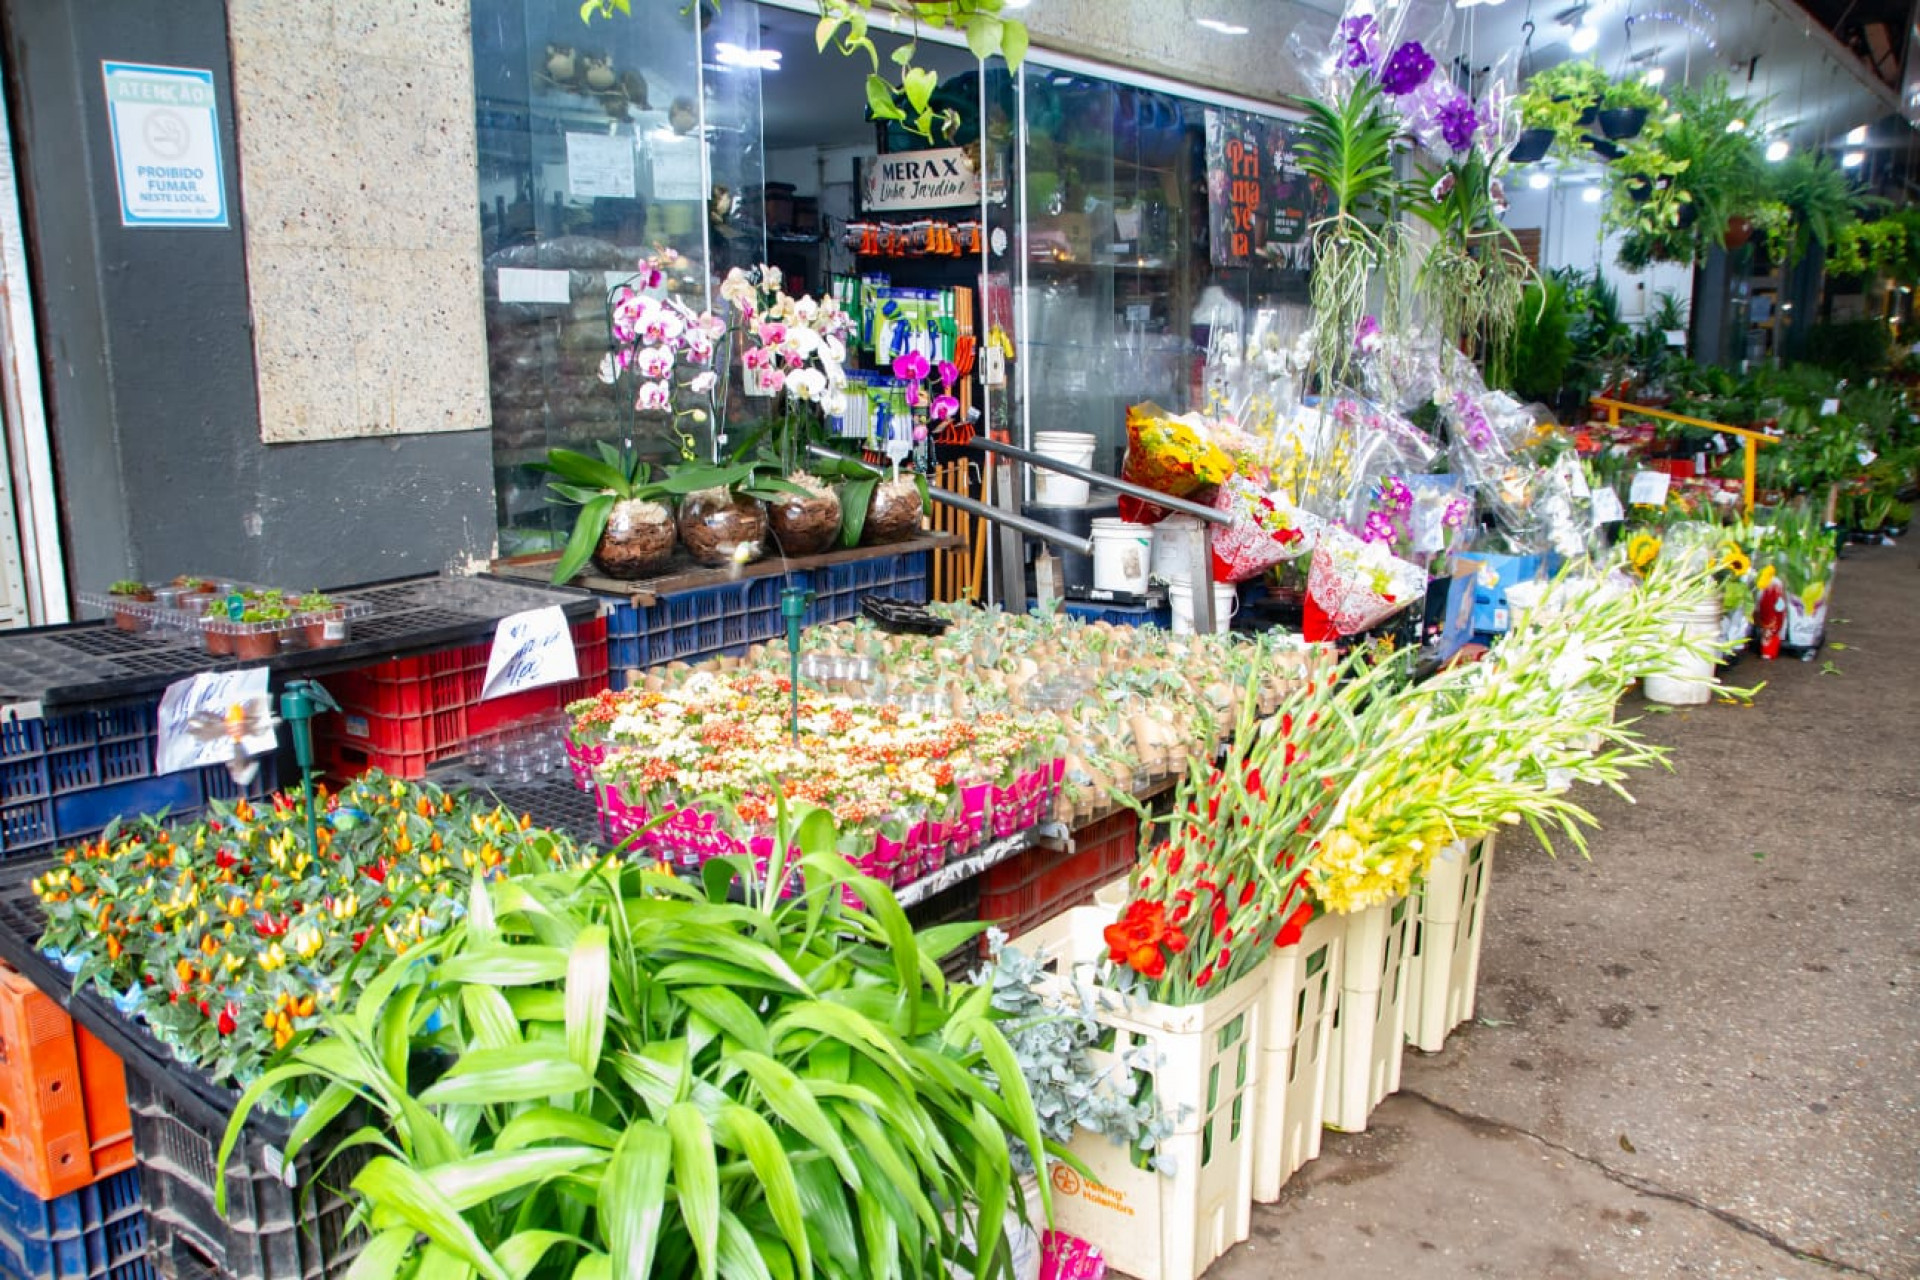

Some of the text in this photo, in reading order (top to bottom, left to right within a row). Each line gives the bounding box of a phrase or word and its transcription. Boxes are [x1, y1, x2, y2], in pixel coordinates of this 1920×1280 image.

[118, 80, 205, 101] ATENÇÃO
[137, 165, 204, 179] PROIBIDO
[882, 157, 960, 181] MERAX
[147, 179, 197, 192] FUMAR
[139, 192, 207, 203] NESTE LOCAL
